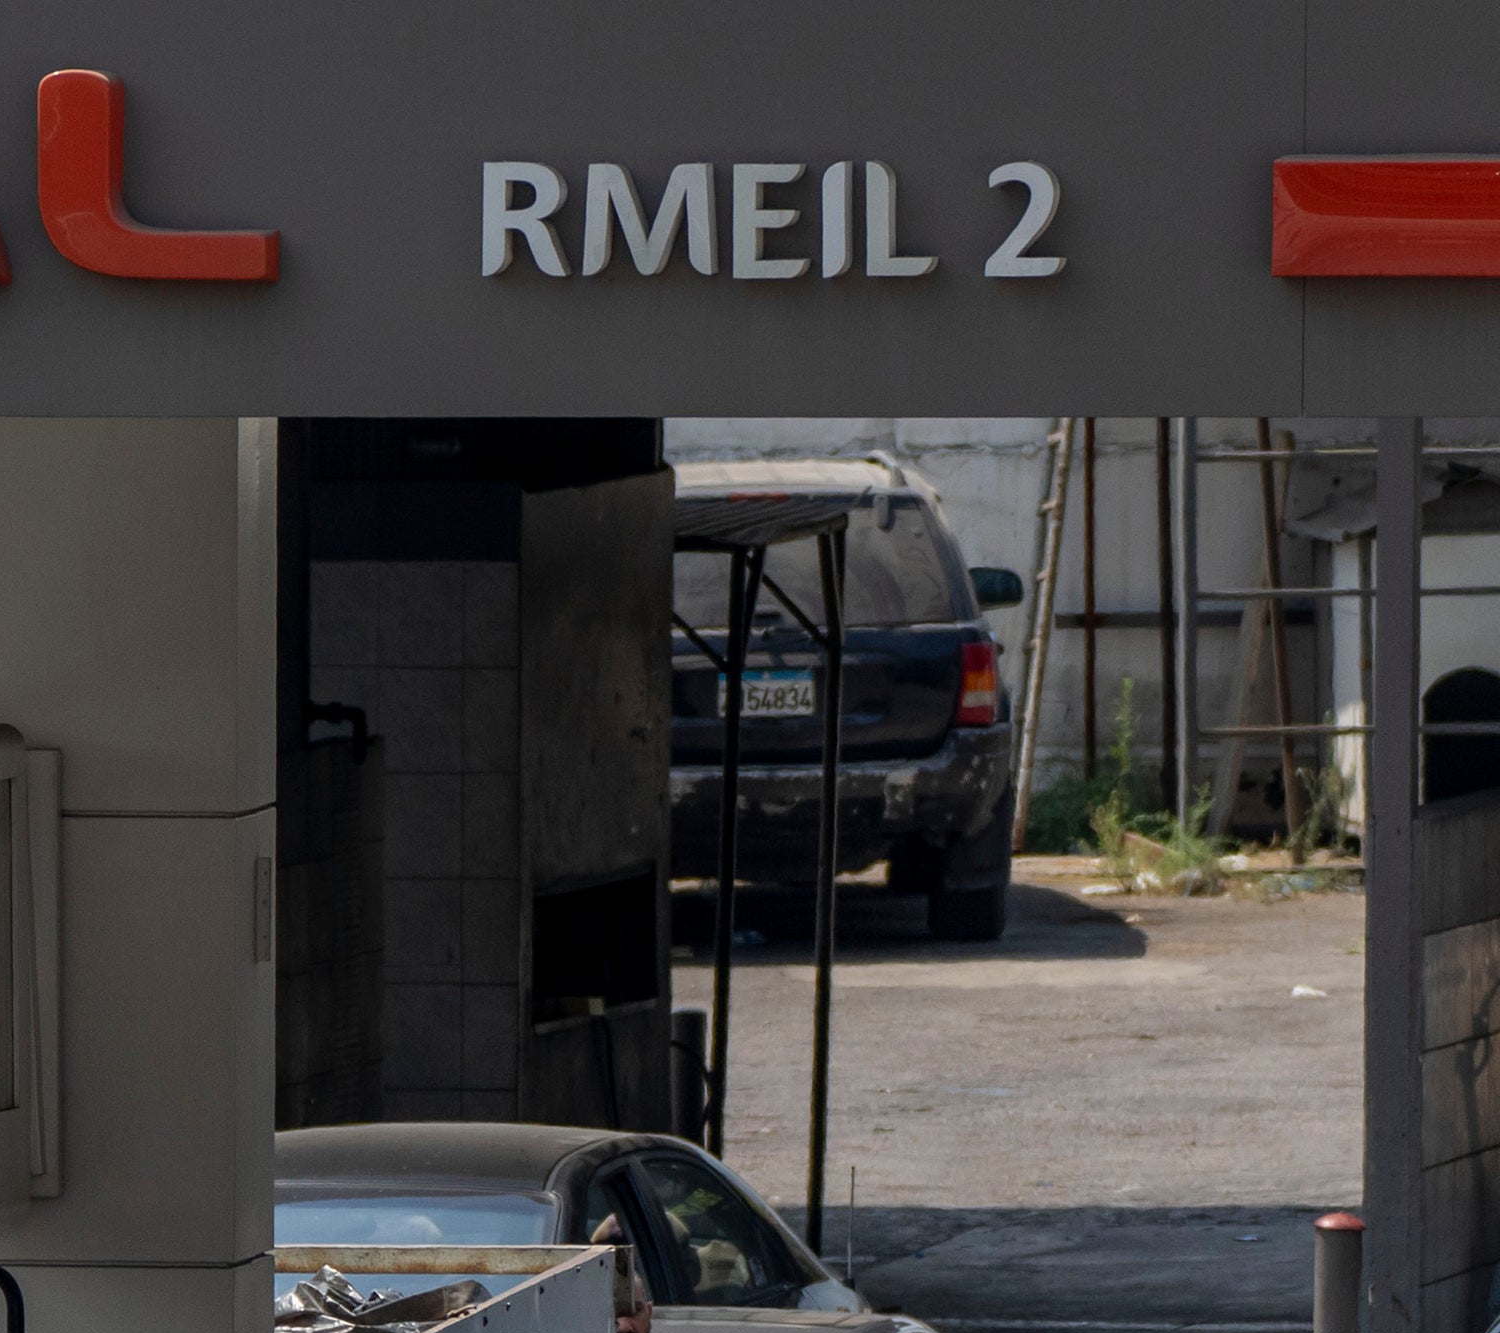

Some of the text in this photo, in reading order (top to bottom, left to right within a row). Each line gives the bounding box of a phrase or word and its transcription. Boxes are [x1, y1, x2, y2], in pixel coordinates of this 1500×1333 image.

[481, 158, 1067, 281] RMEIL 2
[741, 686, 811, 711] 54834
